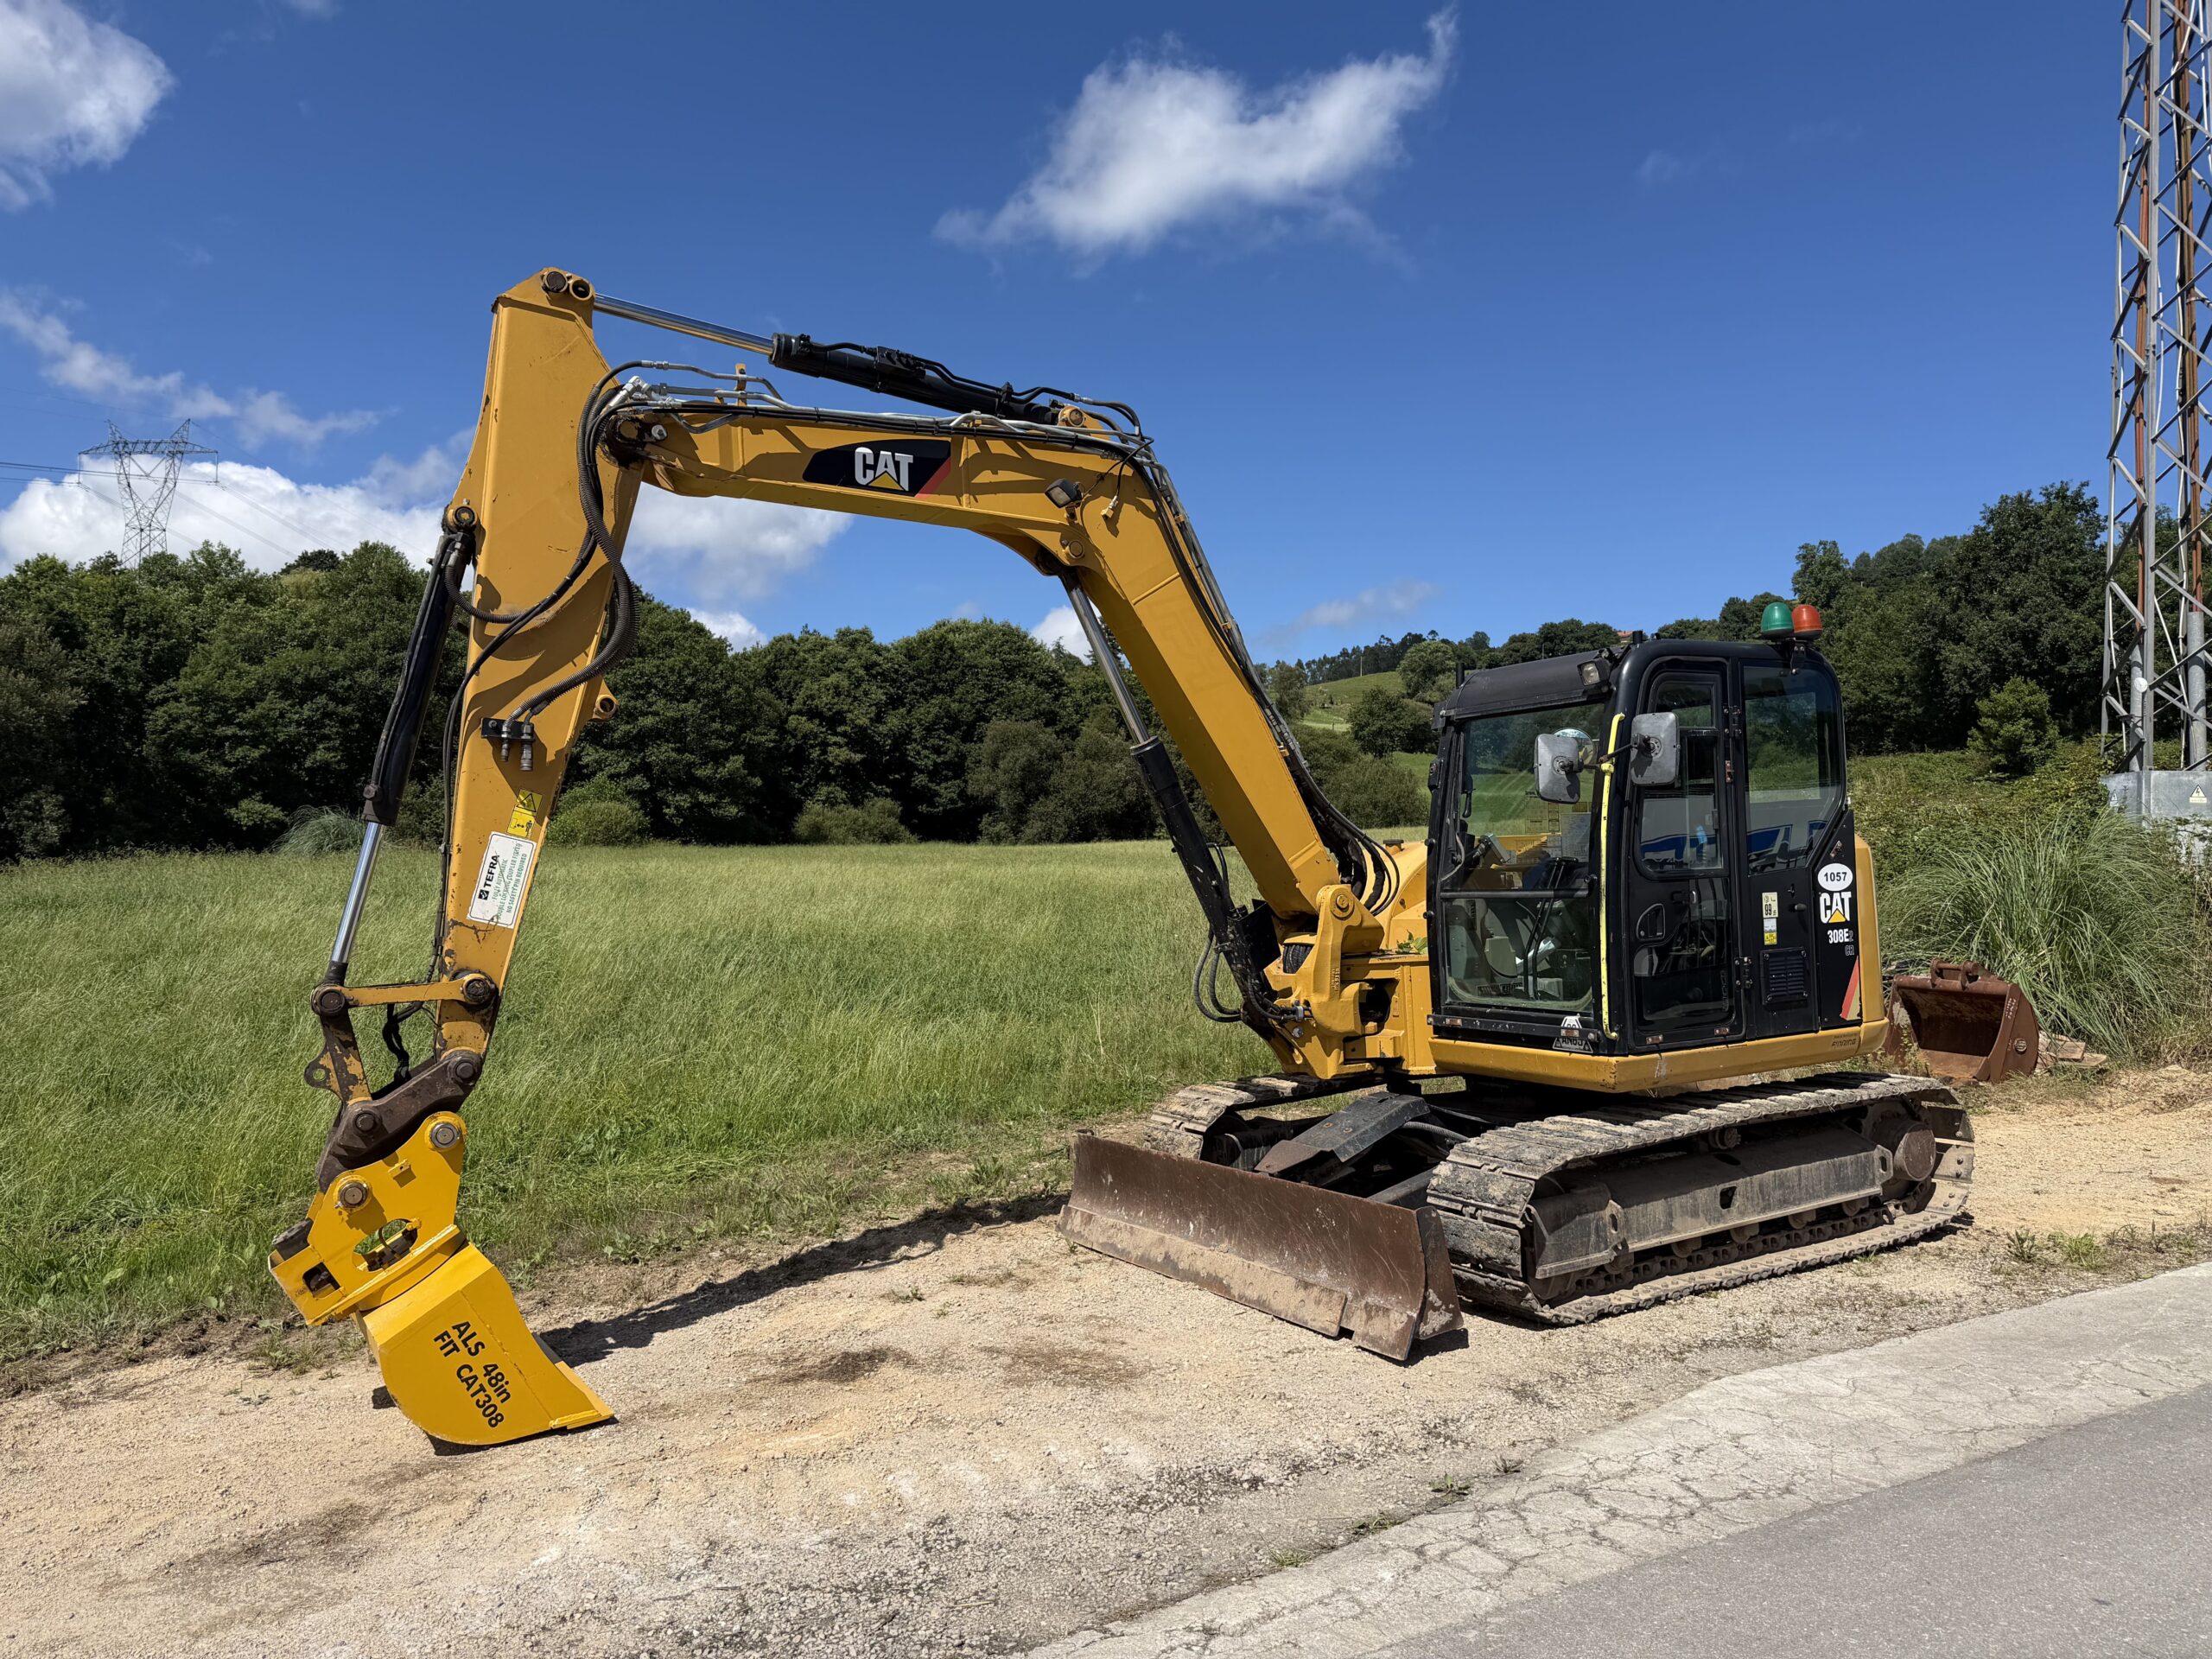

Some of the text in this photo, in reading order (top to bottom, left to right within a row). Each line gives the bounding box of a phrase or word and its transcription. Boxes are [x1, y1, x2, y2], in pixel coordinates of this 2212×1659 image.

[855, 447, 913, 491] CAT
[484, 855, 499, 888] TEFRA
[509, 887, 518, 906] SAFETY
[516, 853, 527, 879] REQUIRED
[1823, 872, 1847, 882] 1057
[1764, 903, 1772, 916] 99
[1820, 891, 1852, 924] CAT
[434, 1330, 505, 1428] FIT CAT308
[451, 1320, 512, 1404] ALS 48in
